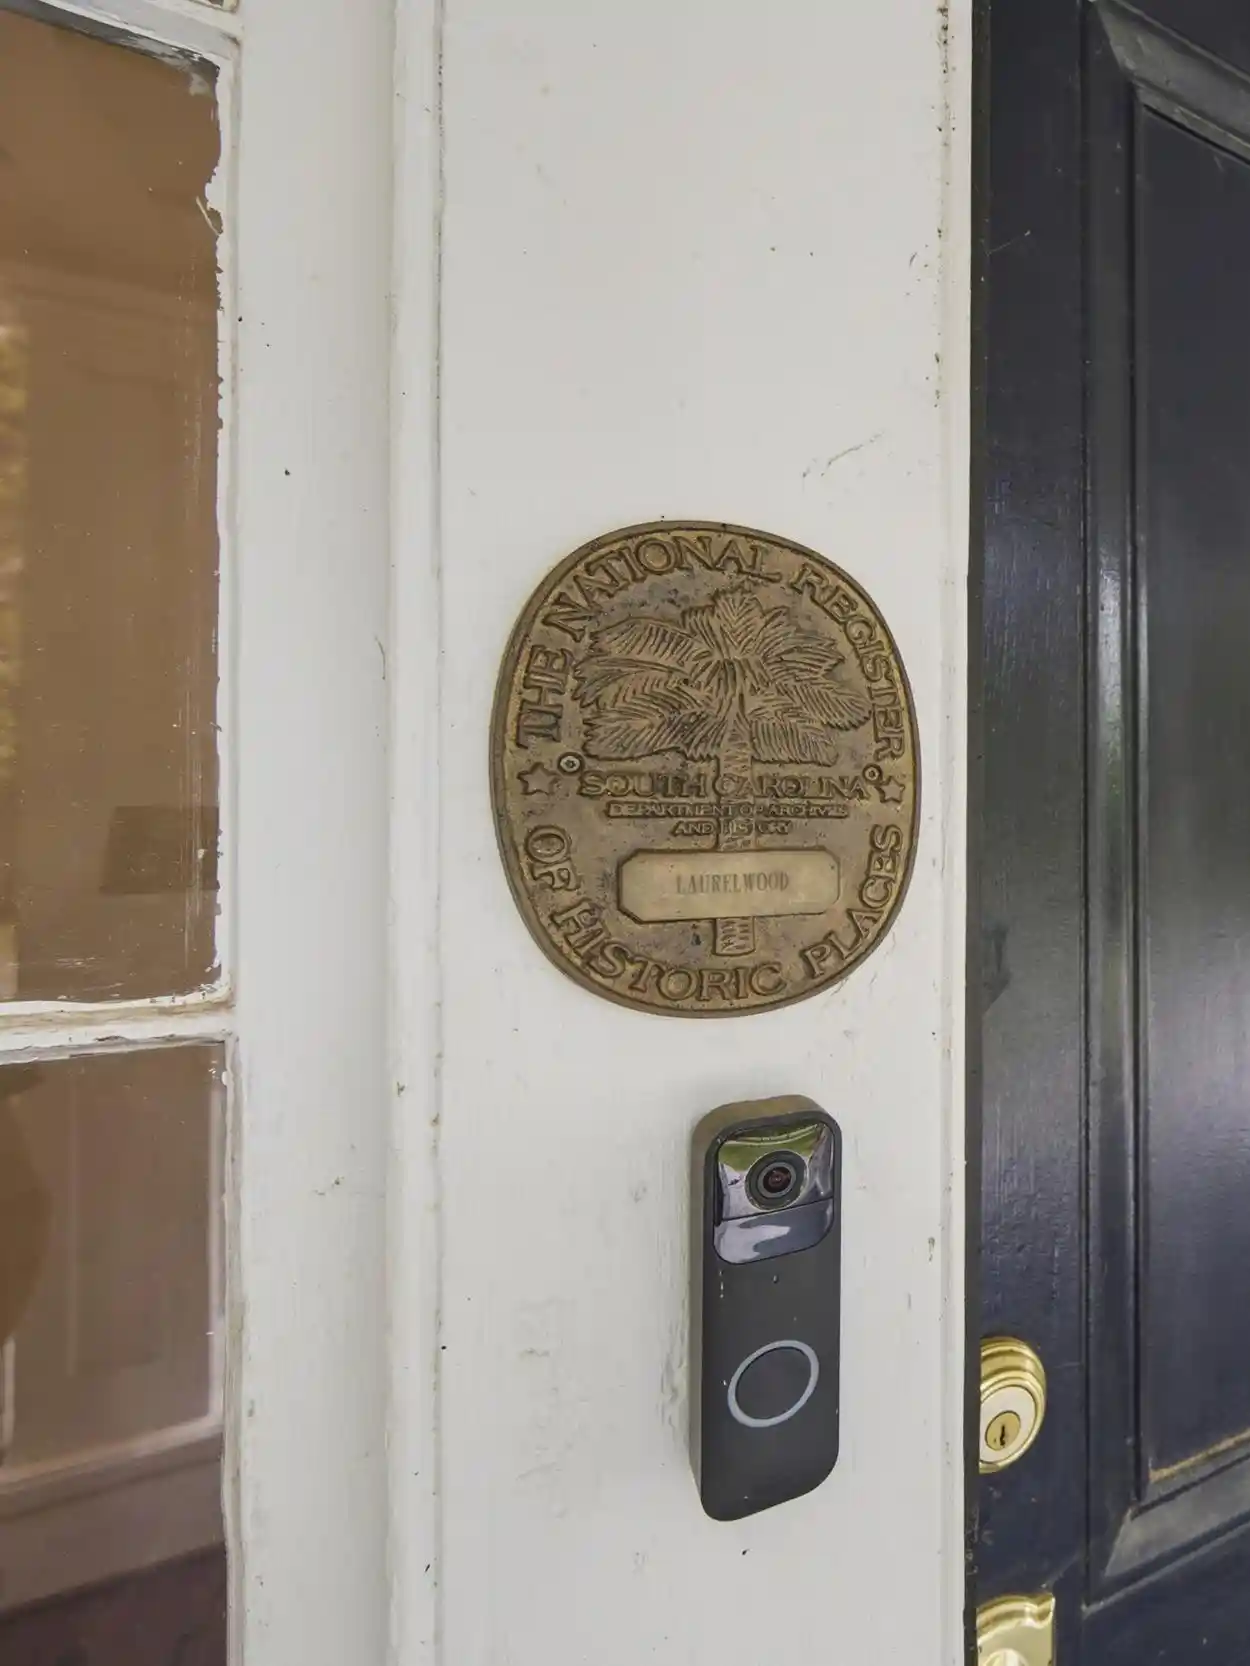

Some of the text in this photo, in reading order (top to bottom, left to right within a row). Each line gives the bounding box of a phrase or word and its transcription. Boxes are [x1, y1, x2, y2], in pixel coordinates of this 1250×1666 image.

[515, 534, 906, 761] THE NATIONAL REGISTER
[579, 770, 869, 799] SOUTH CAROLINA
[608, 801, 733, 818] DEPARTMENT
[672, 821, 714, 836] AND
[676, 871, 790, 895] LAURELWOOD
[525, 824, 903, 1001] OF HISTORIC PLACES
